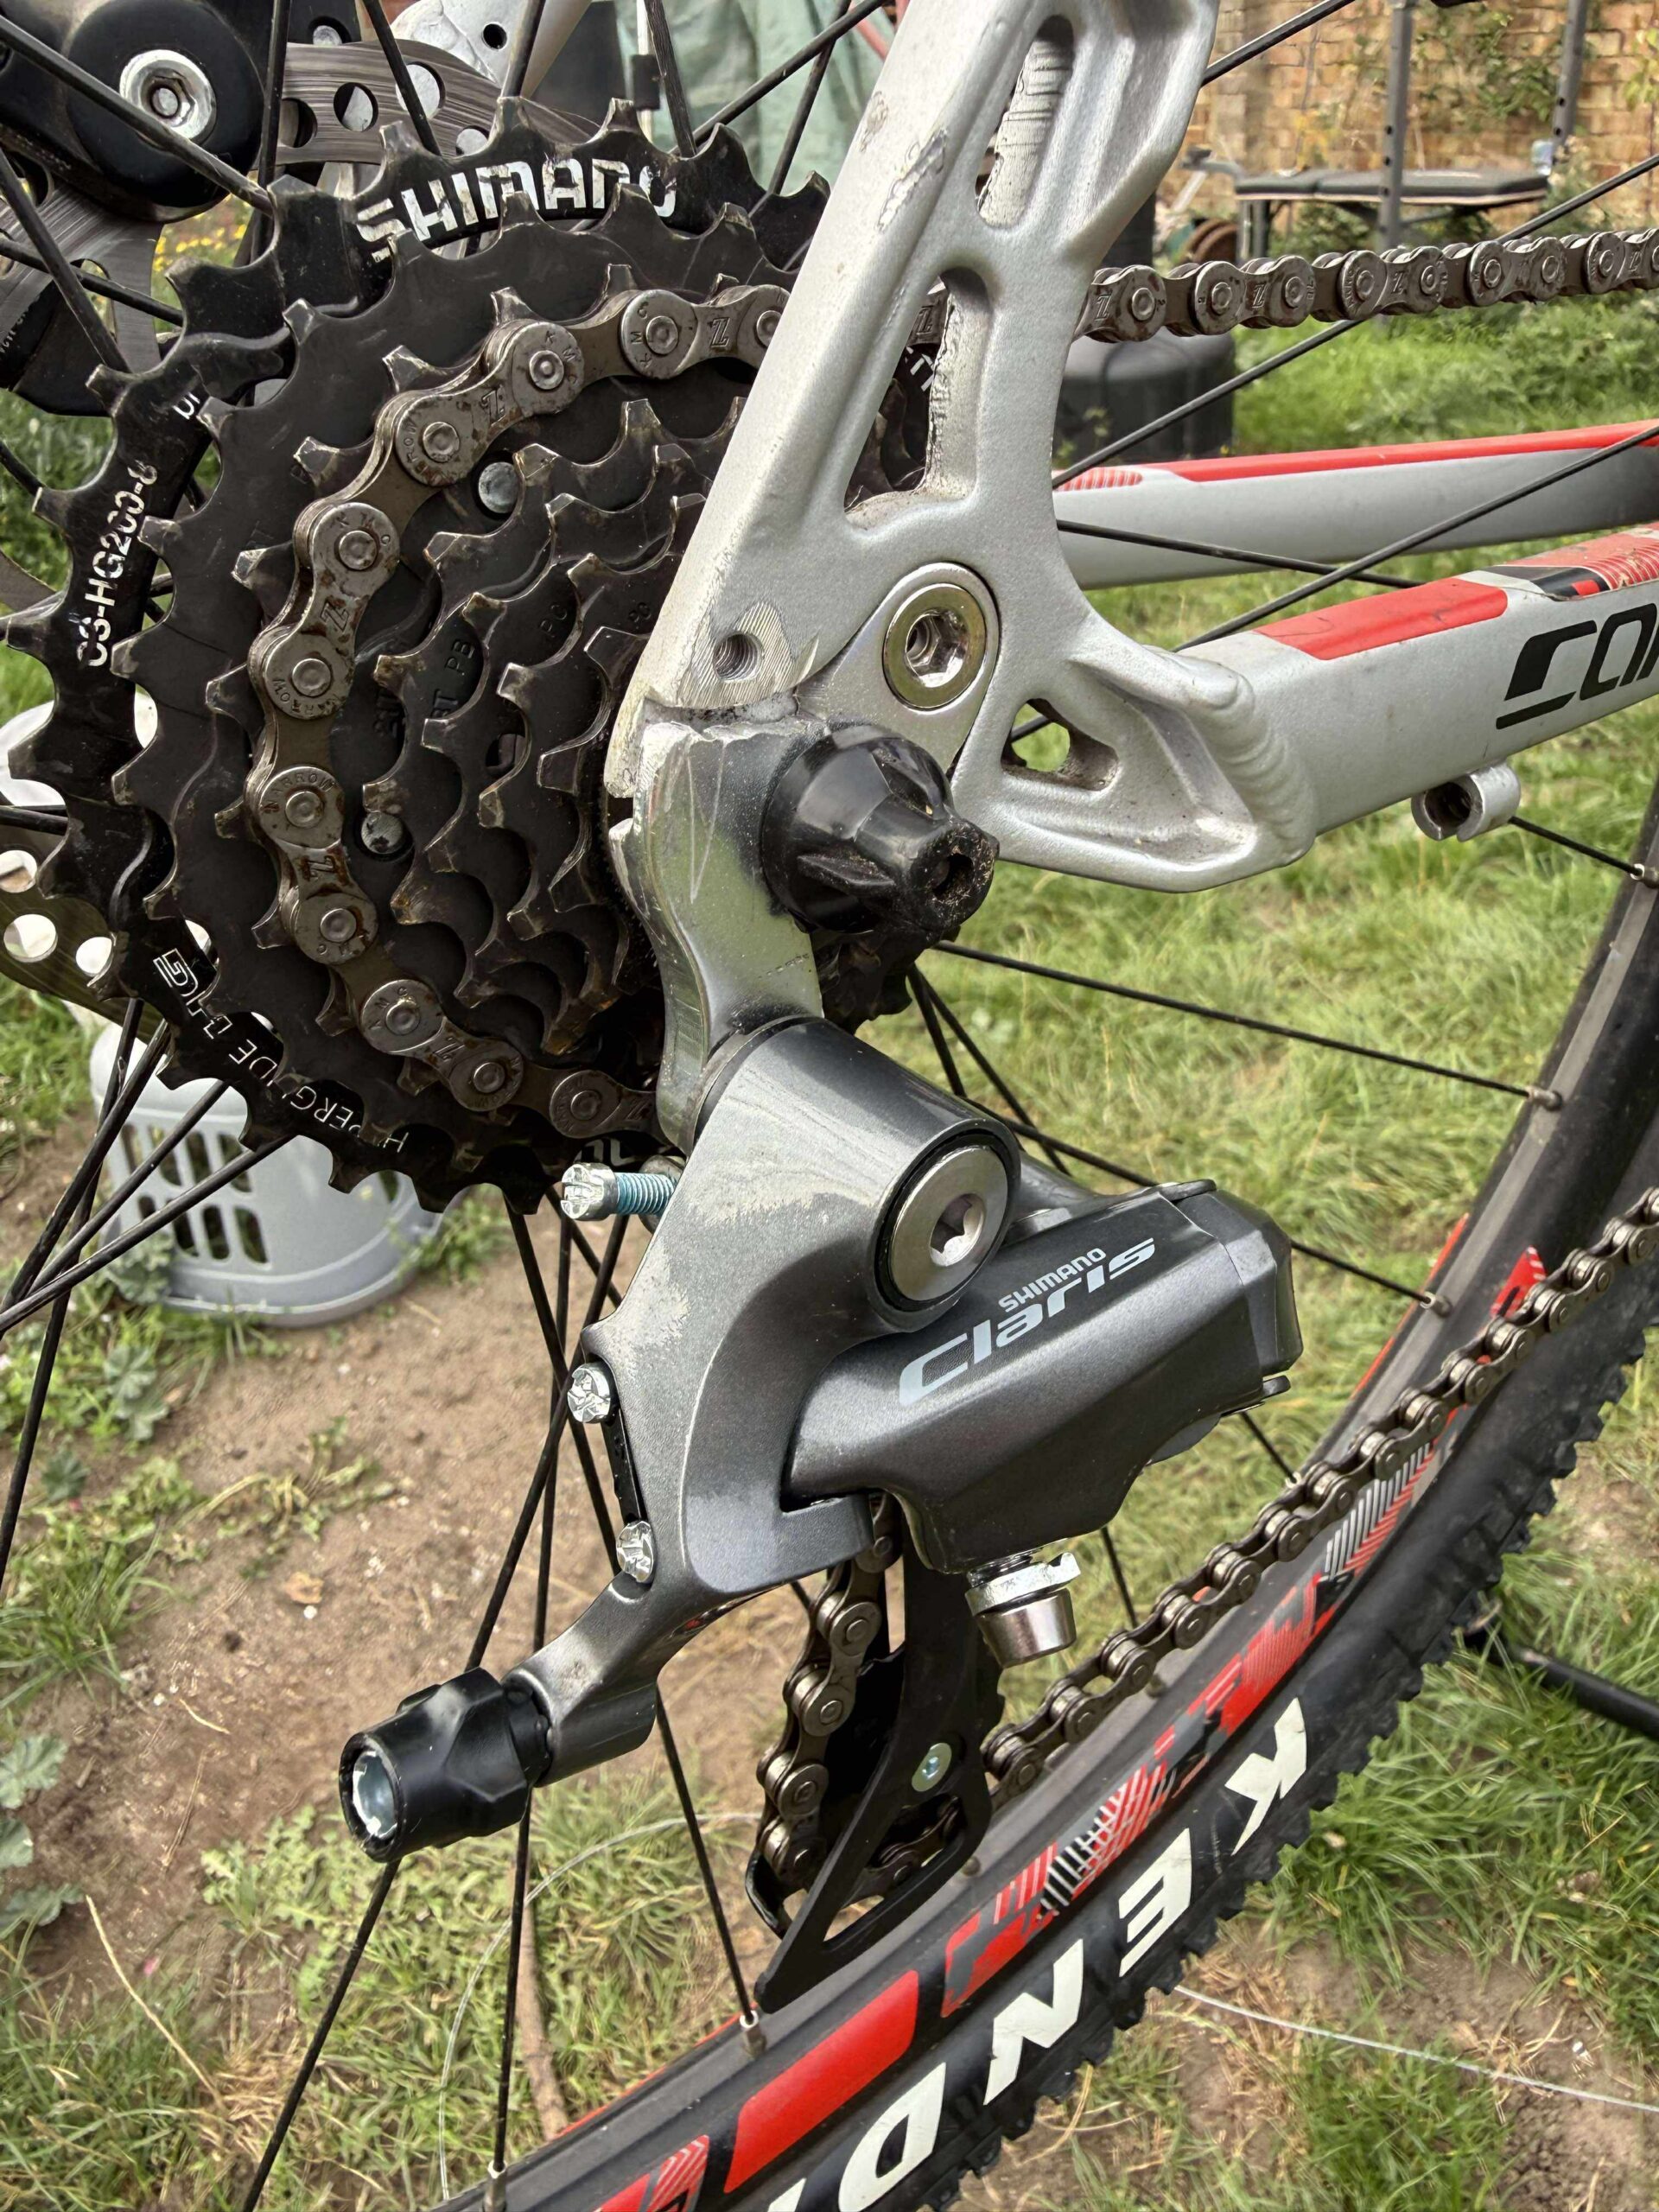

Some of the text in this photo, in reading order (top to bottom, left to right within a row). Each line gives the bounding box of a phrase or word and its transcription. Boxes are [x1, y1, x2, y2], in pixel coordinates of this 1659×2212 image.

[899, 1237, 1156, 1407] Claris
[998, 1248, 1107, 1313] SHIMANO
[766, 1696, 1308, 2212] KEND
